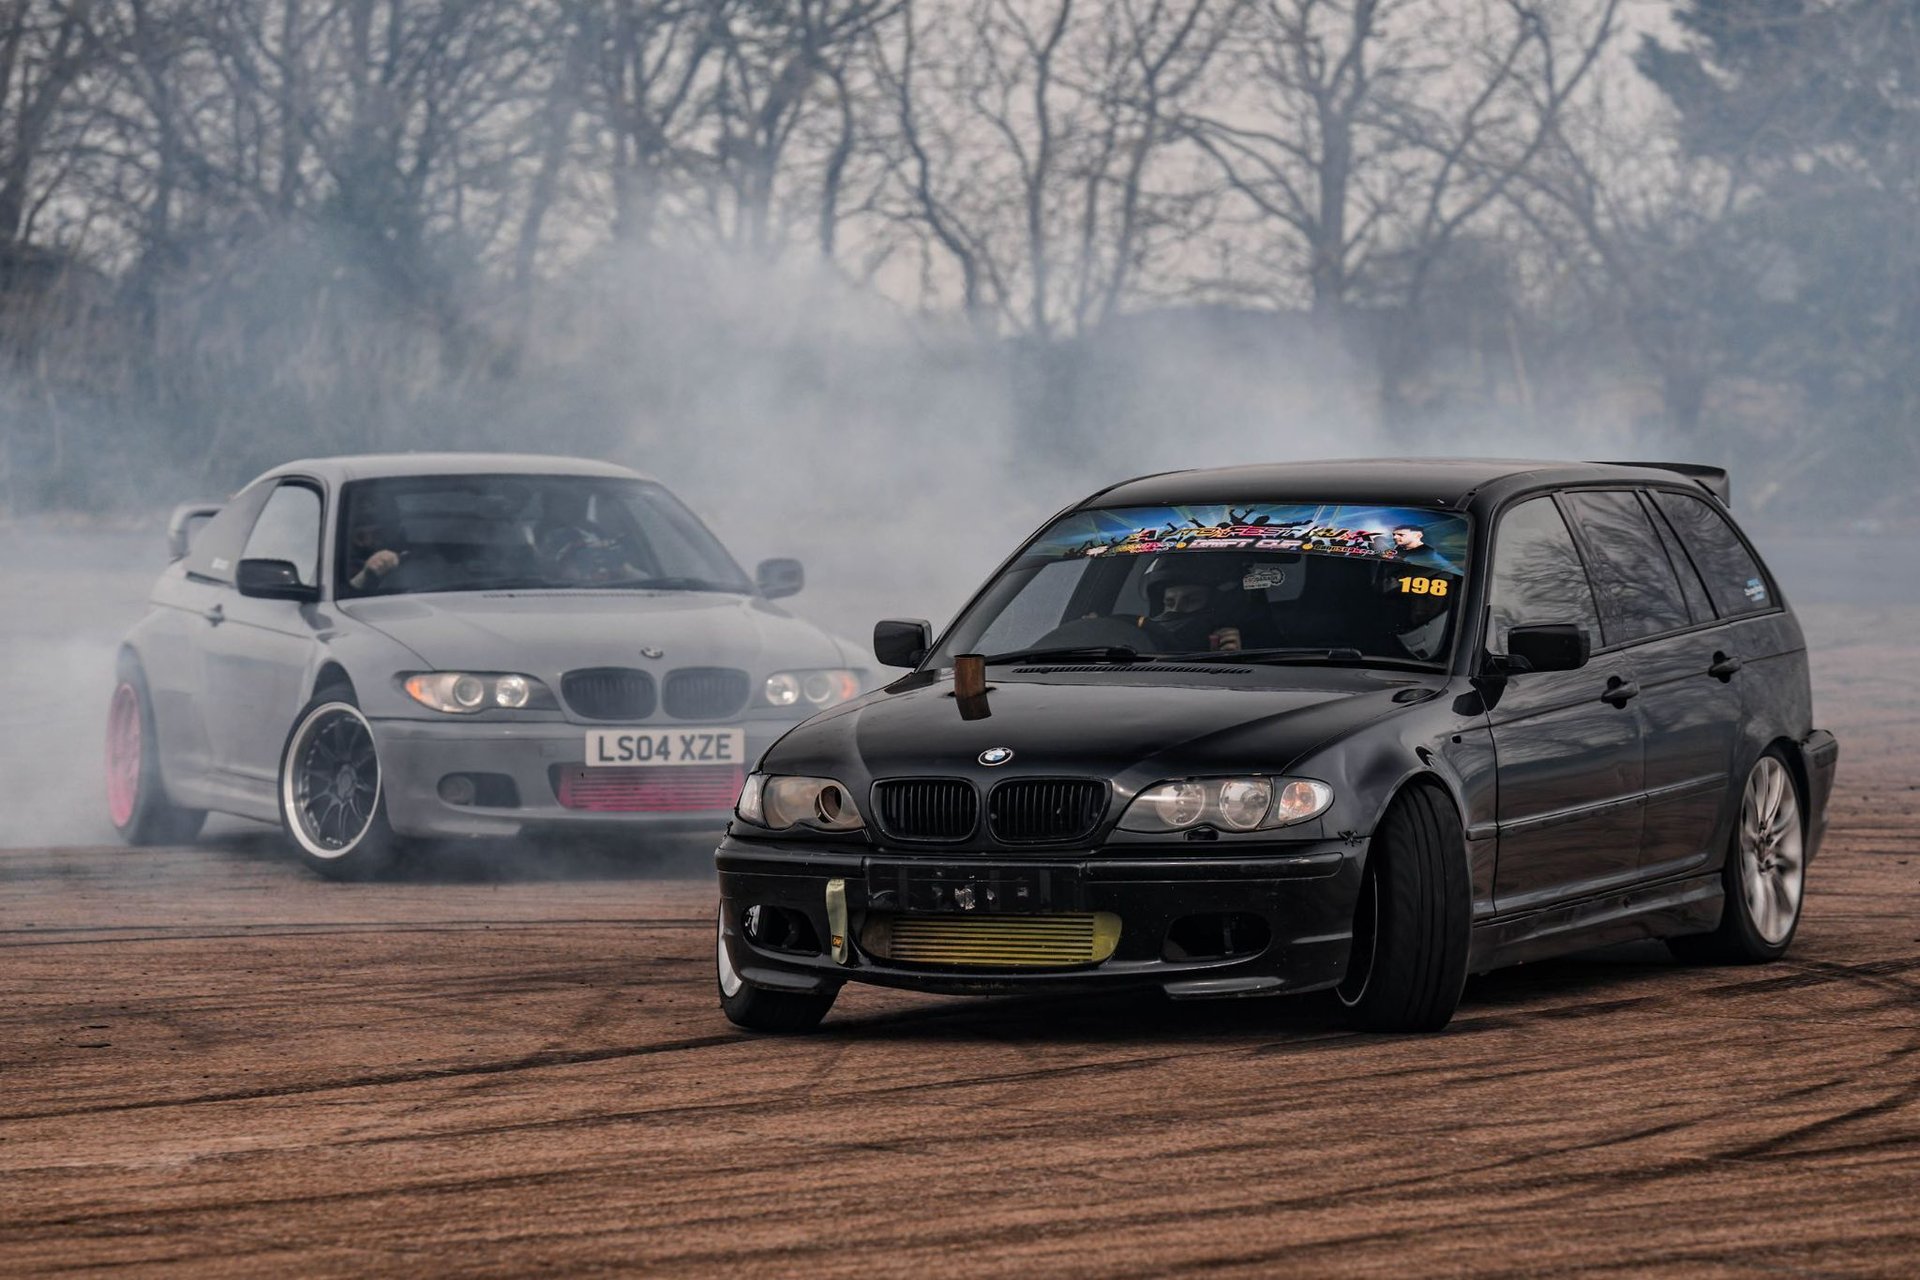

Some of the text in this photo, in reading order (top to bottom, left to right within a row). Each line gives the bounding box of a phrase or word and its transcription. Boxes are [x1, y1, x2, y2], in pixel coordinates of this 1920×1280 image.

[1398, 576, 1448, 596] 198
[598, 733, 732, 762] LS04 XZE
